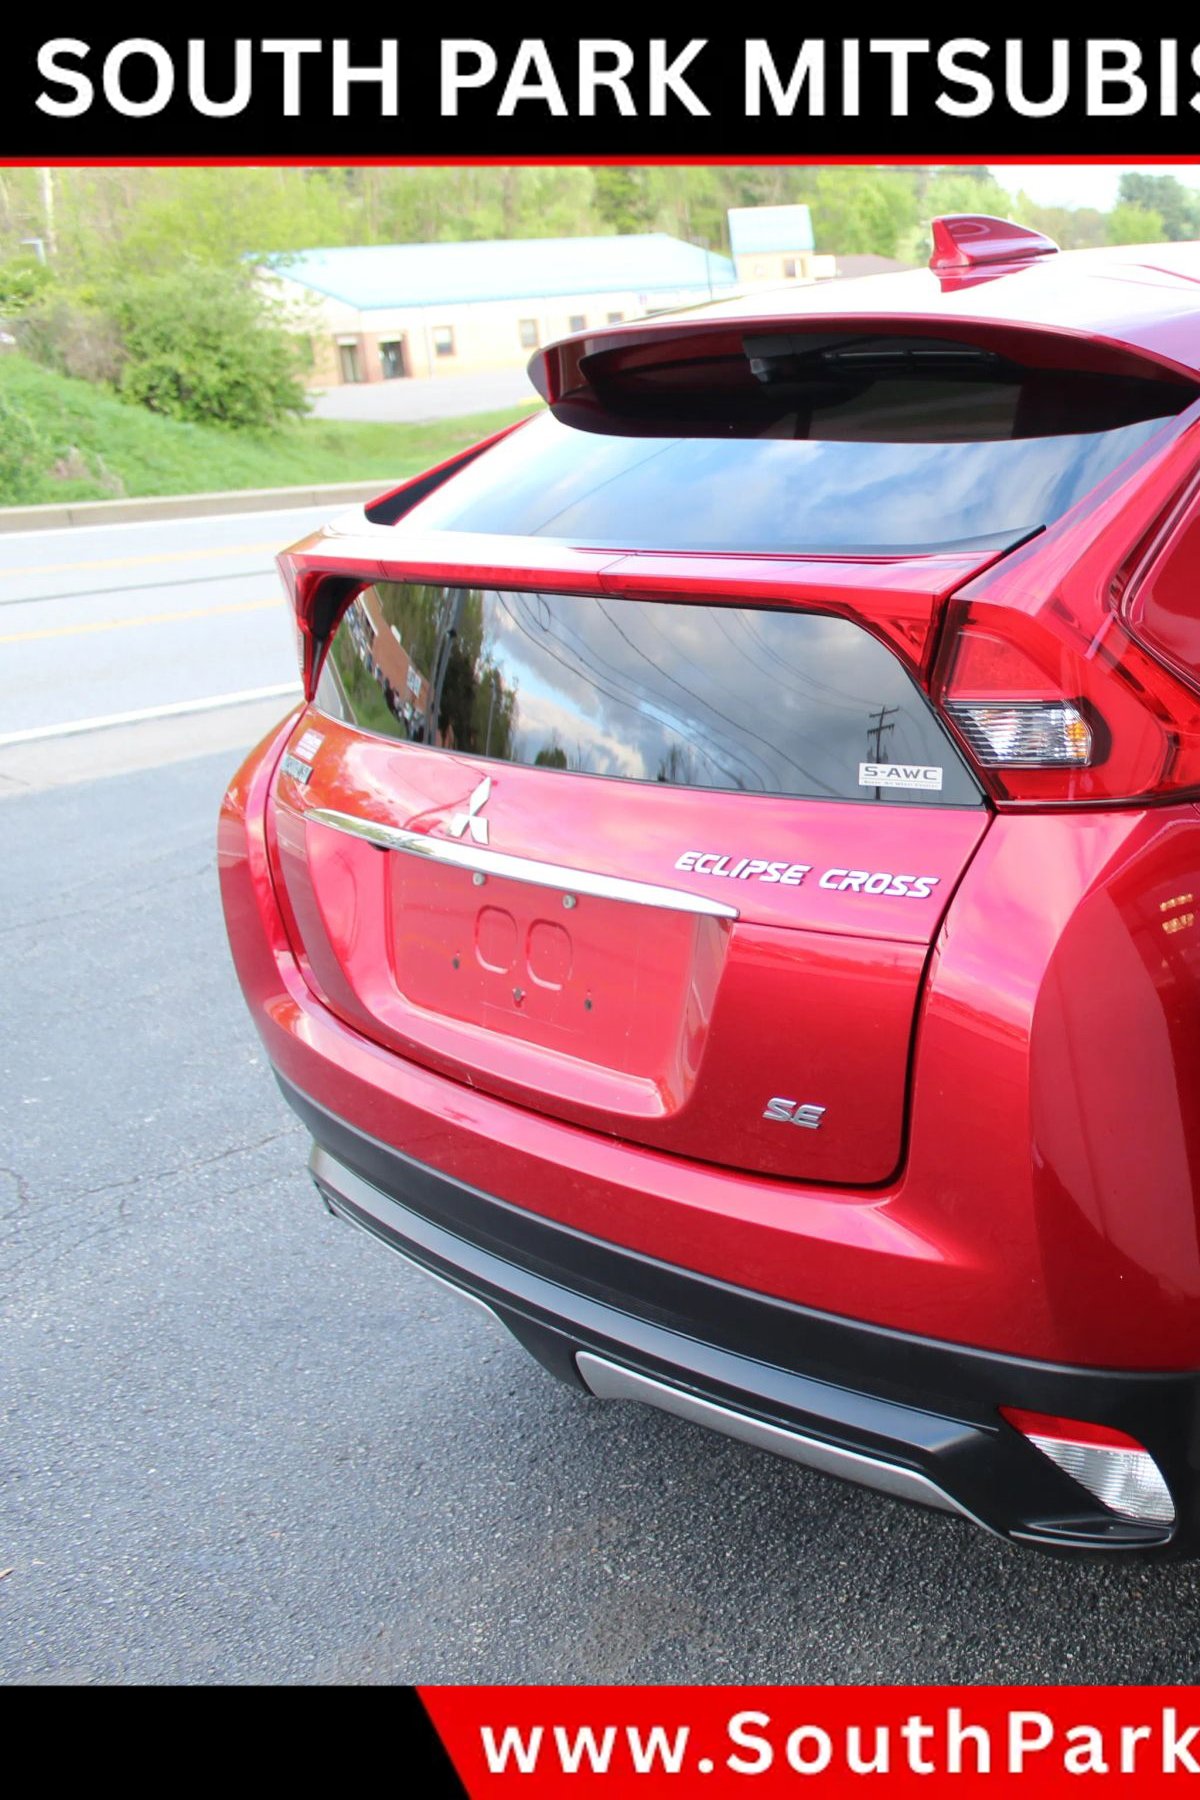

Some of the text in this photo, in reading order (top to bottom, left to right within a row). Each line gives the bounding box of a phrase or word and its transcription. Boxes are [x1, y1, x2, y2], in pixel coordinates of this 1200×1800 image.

[864, 765, 938, 781] S-AWC
[674, 851, 940, 898] ECLIPSE CROSS
[762, 1097, 826, 1129] SE
